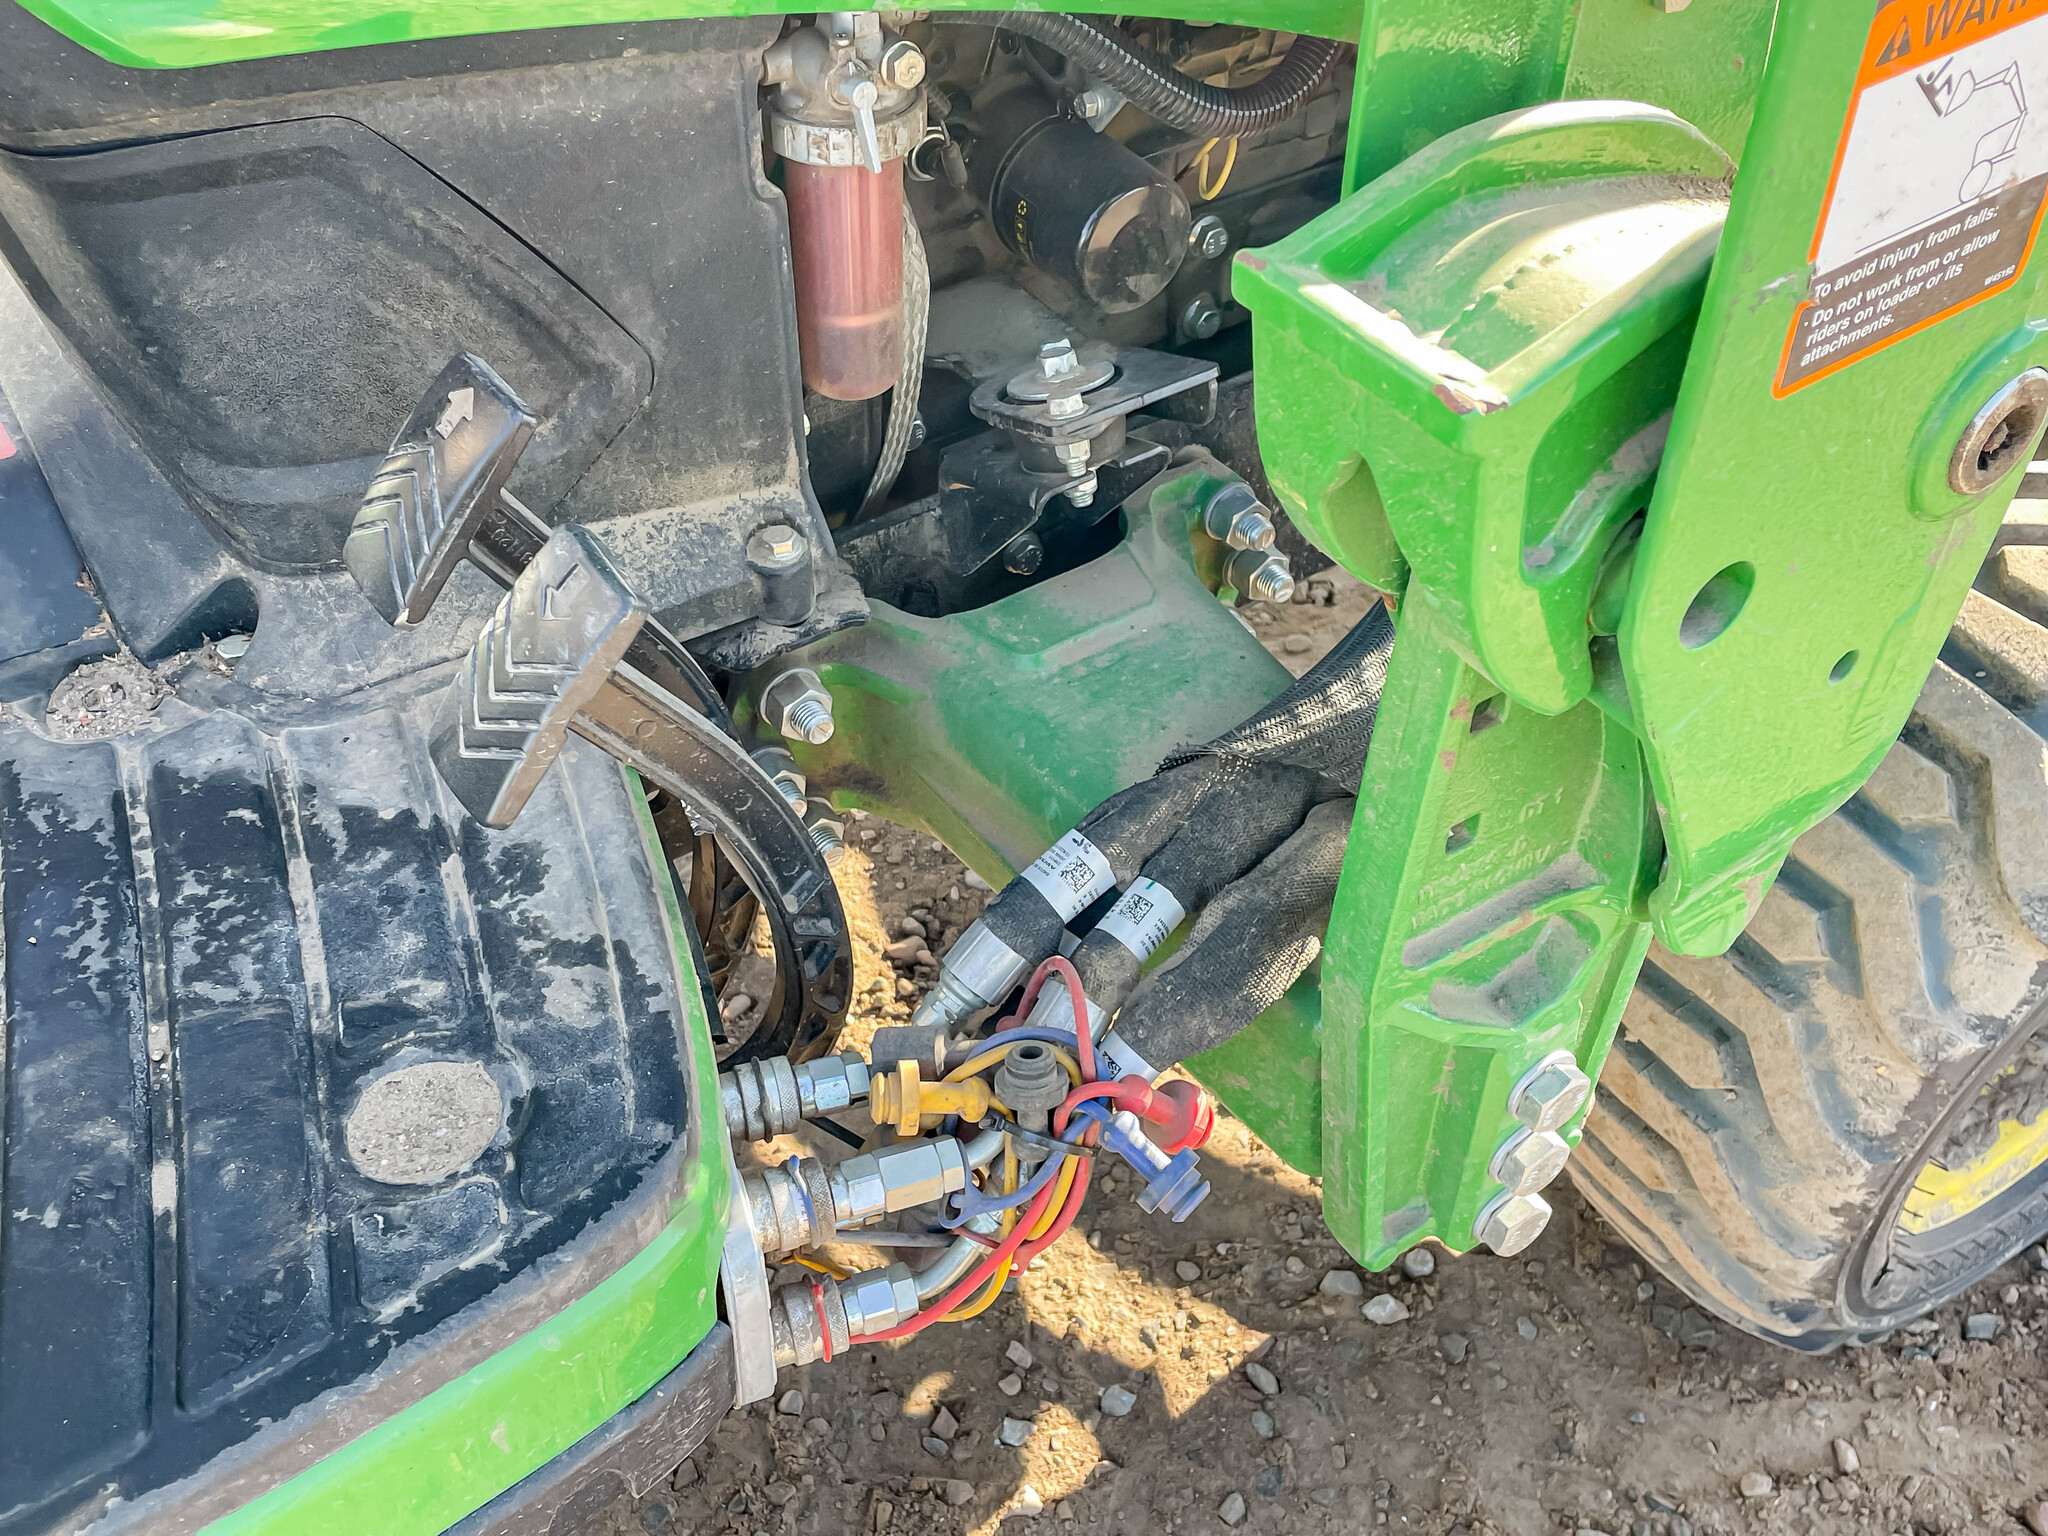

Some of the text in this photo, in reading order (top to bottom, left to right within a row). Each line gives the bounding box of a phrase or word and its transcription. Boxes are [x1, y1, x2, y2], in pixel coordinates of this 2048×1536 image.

[1924, 0, 2040, 46] WA
[1811, 228, 2000, 328] Do not work from or allow
[1814, 205, 2000, 298] To avoid injury from falls:
[1984, 264, 2016, 287] W45192
[1805, 261, 1965, 348] riders on loader or its
[1800, 313, 1896, 368] attachments.
